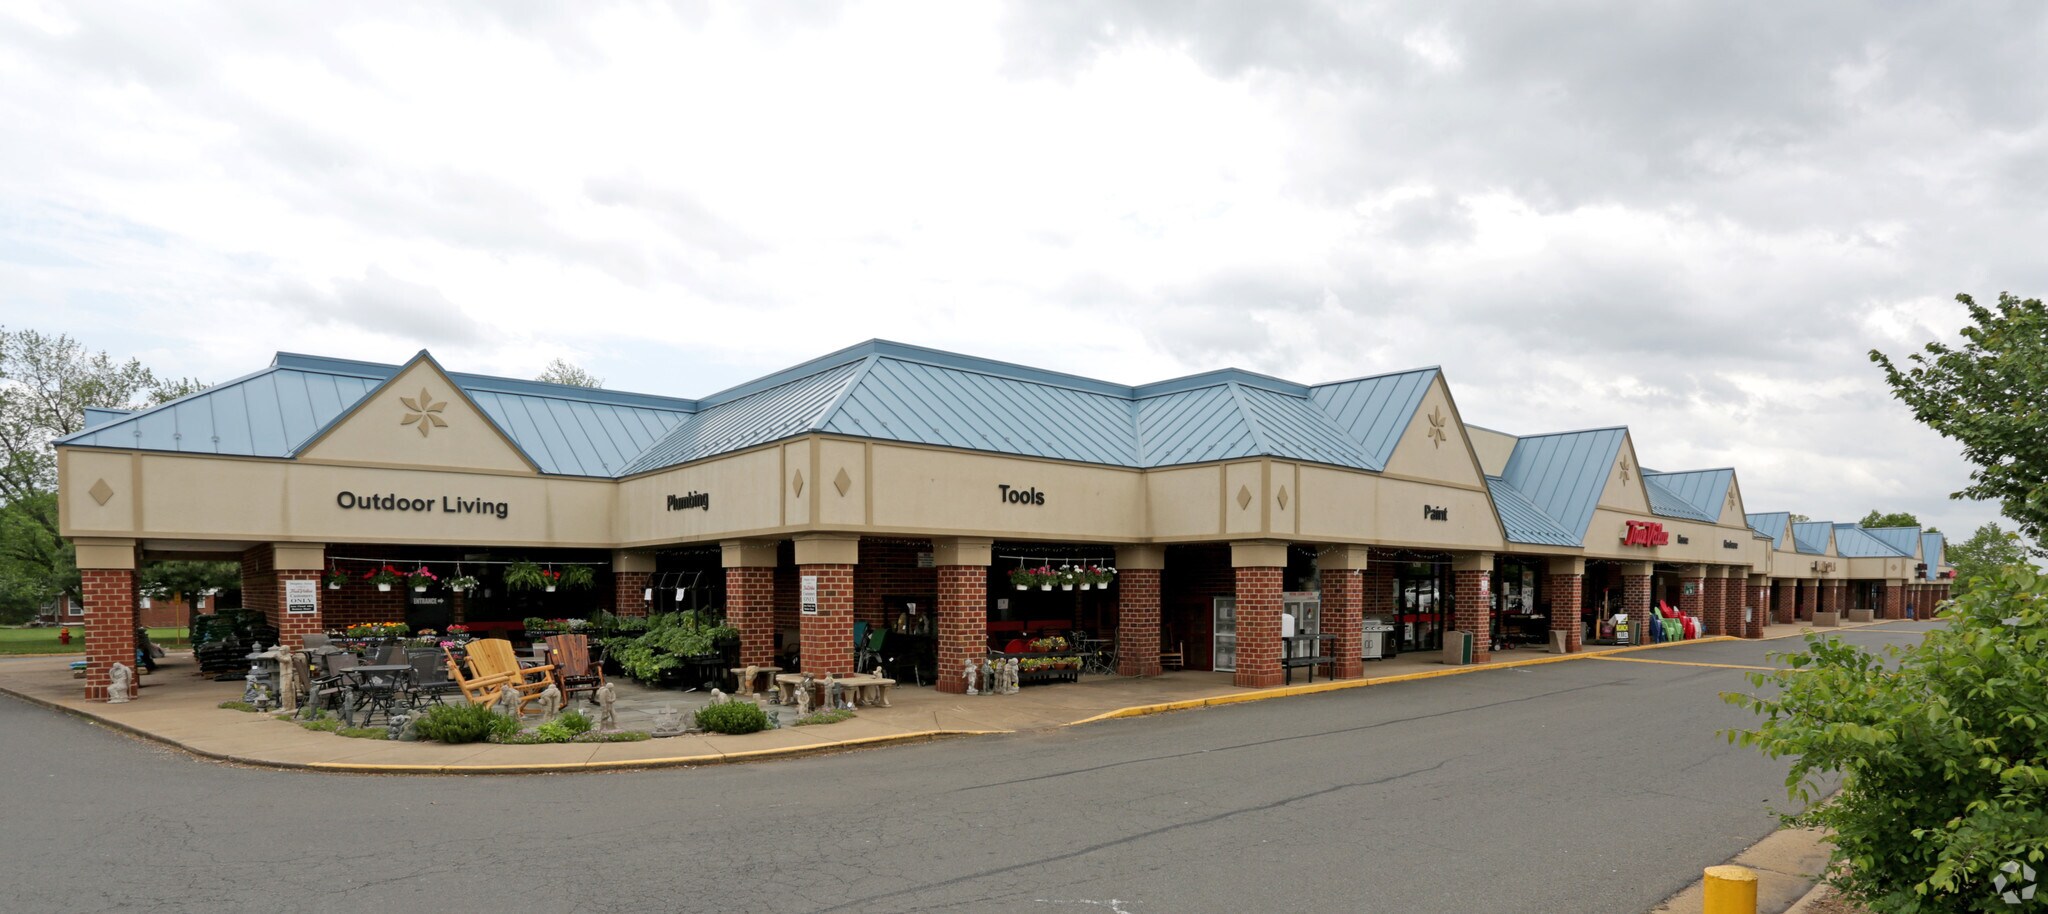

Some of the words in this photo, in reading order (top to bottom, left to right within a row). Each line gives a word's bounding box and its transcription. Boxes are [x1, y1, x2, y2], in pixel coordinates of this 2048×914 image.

[336, 491, 435, 512] Outdoor
[443, 495, 509, 519] Living
[667, 490, 709, 511] Plumbing
[998, 484, 1045, 506] Tools
[1424, 504, 1448, 521] Paint
[413, 597, 437, 605] ENTRANCE
